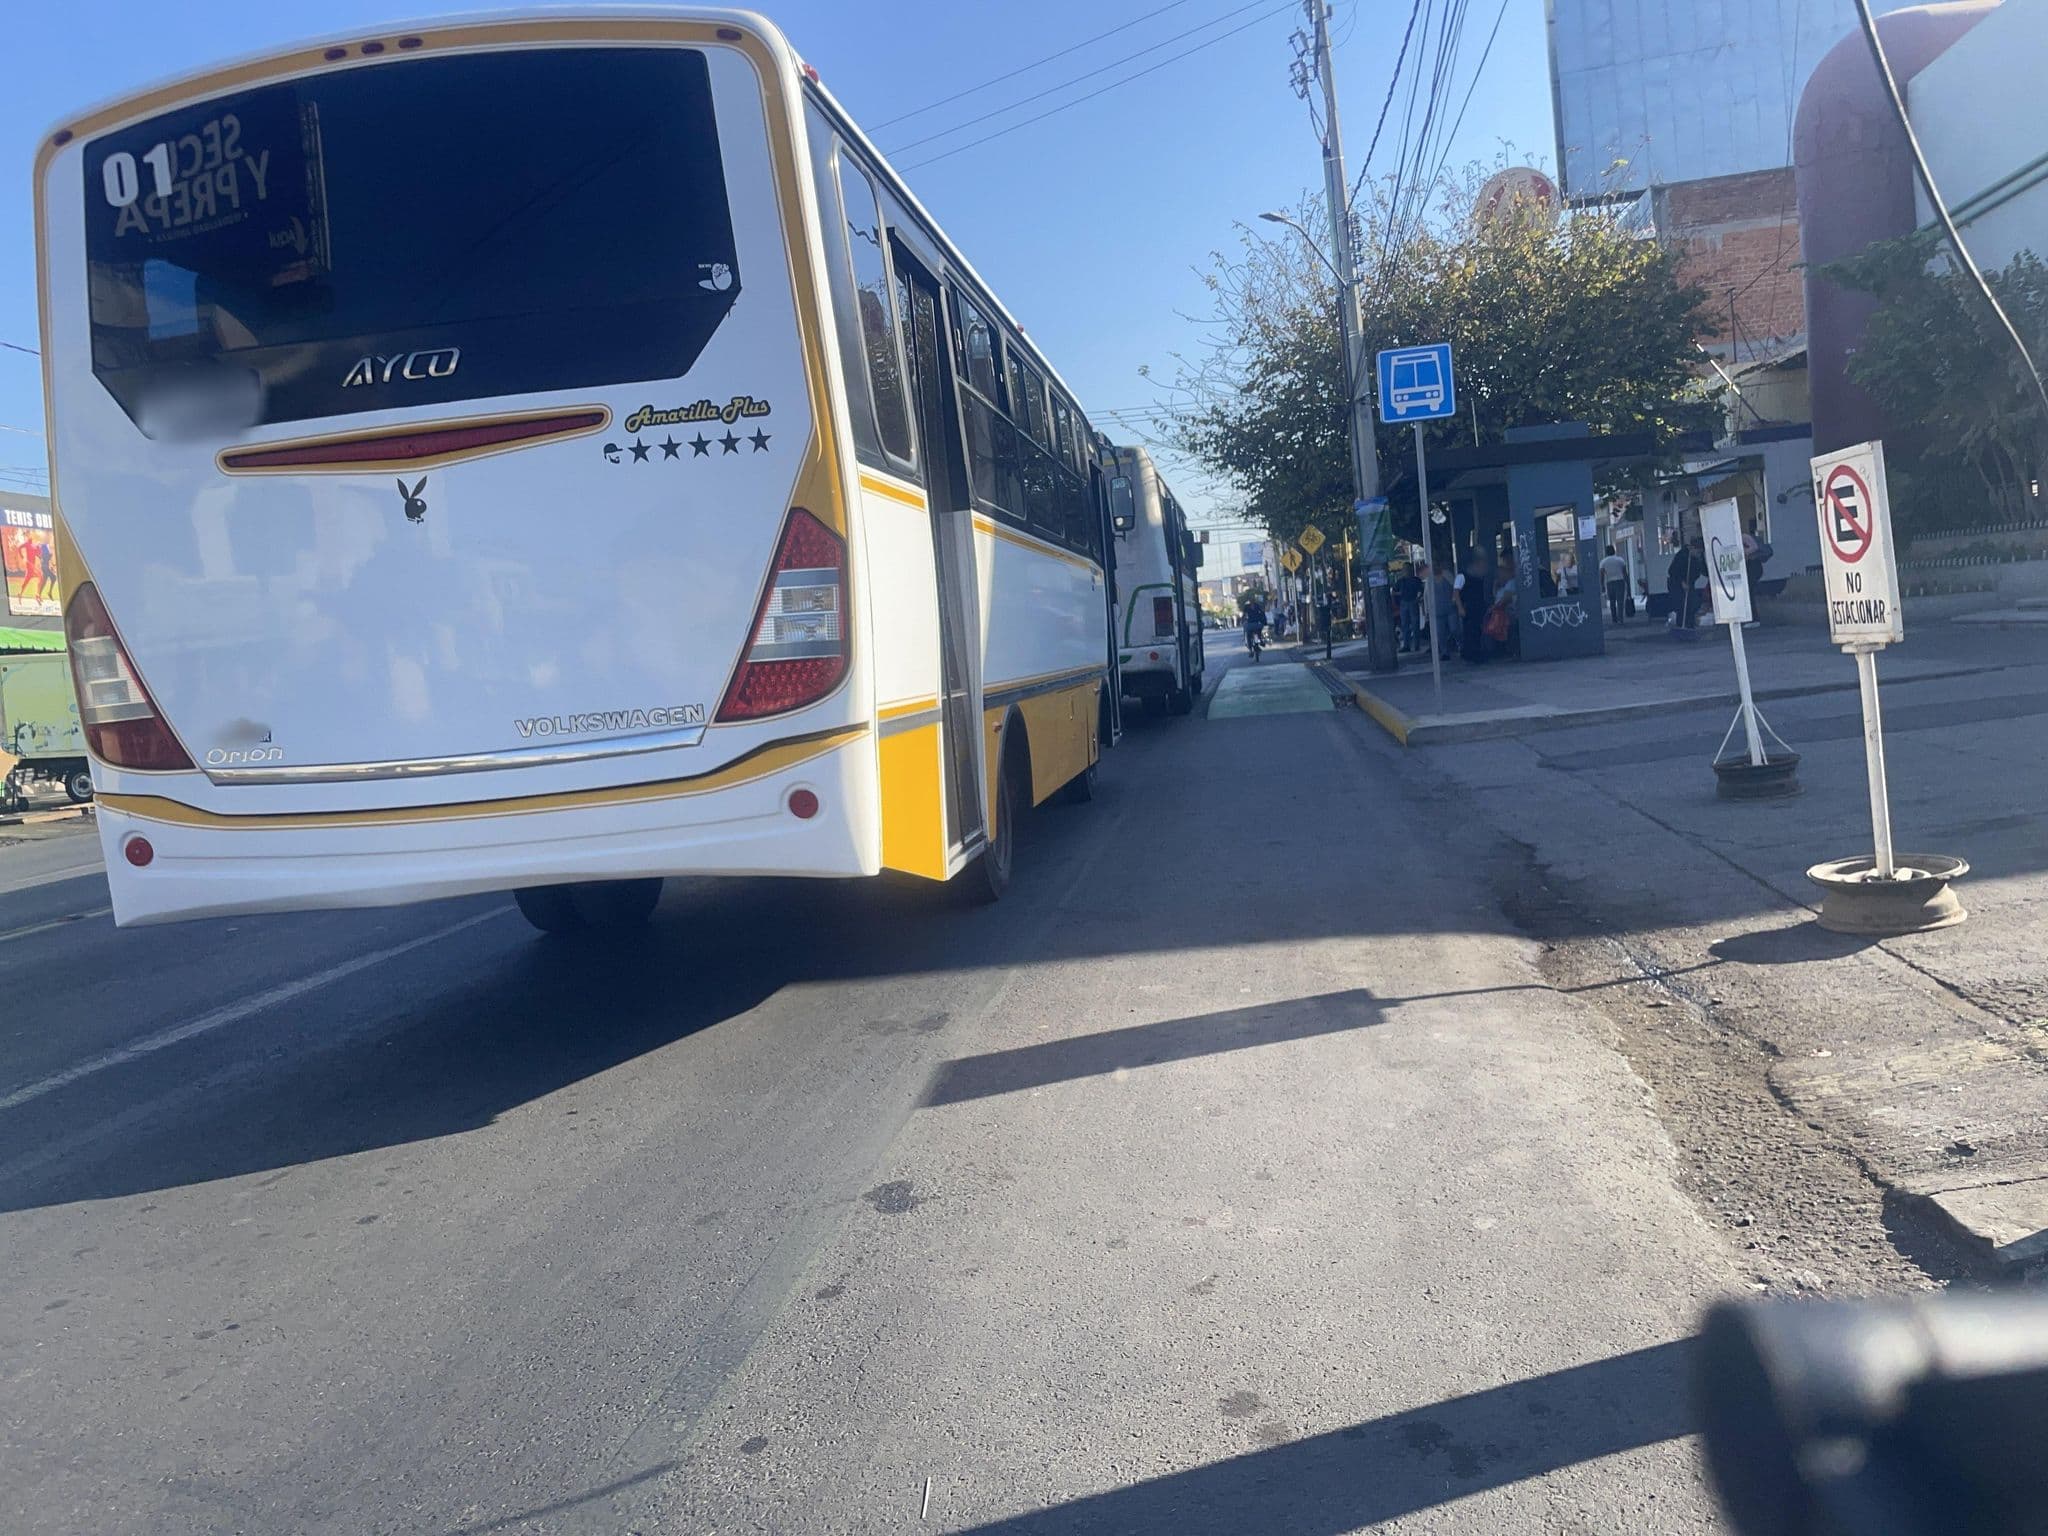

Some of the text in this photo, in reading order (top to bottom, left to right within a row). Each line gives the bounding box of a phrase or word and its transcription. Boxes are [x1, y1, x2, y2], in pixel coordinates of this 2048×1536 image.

[102, 142, 174, 207] 01
[342, 347, 460, 388] AYCO
[625, 396, 771, 433] Amarilla Plus
[1845, 572, 1862, 594] NO
[1832, 599, 1886, 625] ESTACIONAR
[515, 703, 706, 737] VOLKSWAGEN
[207, 748, 283, 764] Orion
